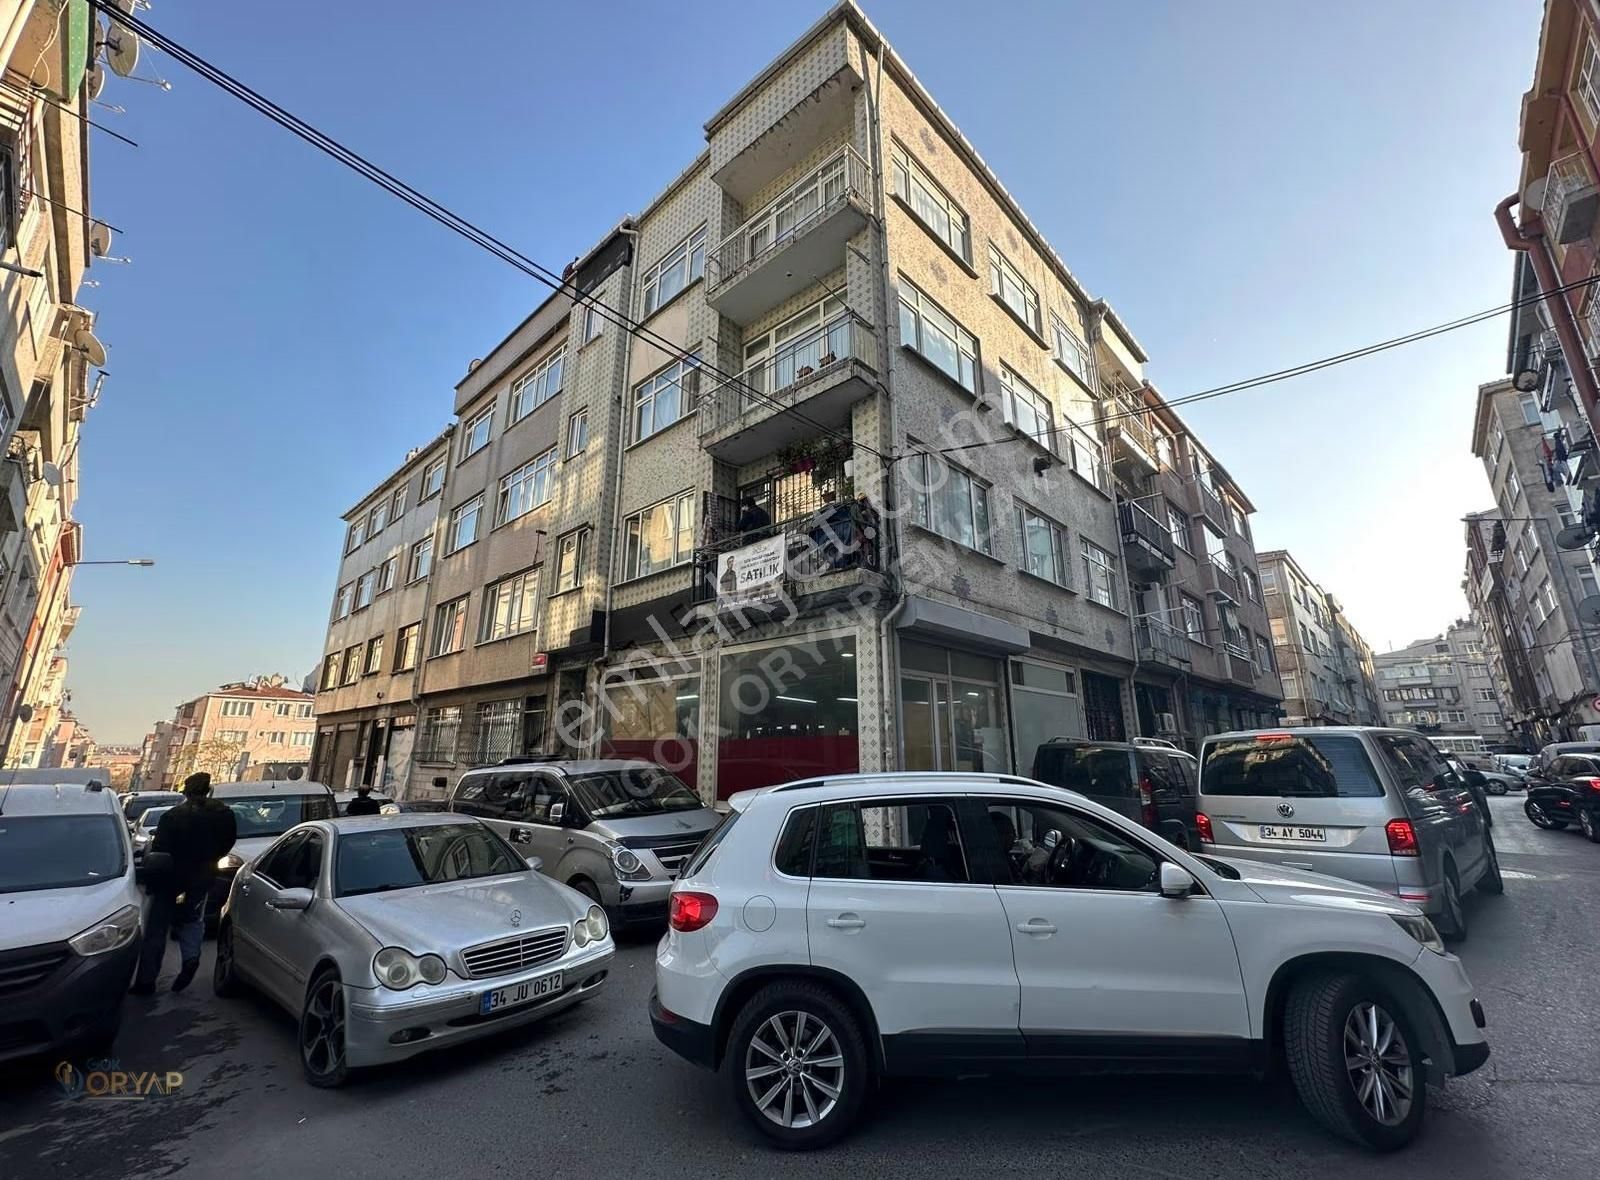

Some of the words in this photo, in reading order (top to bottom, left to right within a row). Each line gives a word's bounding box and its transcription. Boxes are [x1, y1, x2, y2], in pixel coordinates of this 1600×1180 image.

[740, 563, 780, 583] SATILIK
[1265, 827, 1277, 837] 34
[1283, 828, 1293, 838] AY
[1299, 828, 1323, 840] 5044
[491, 991, 507, 1008] 34
[514, 982, 528, 1002] JU
[534, 974, 561, 997] 0612
